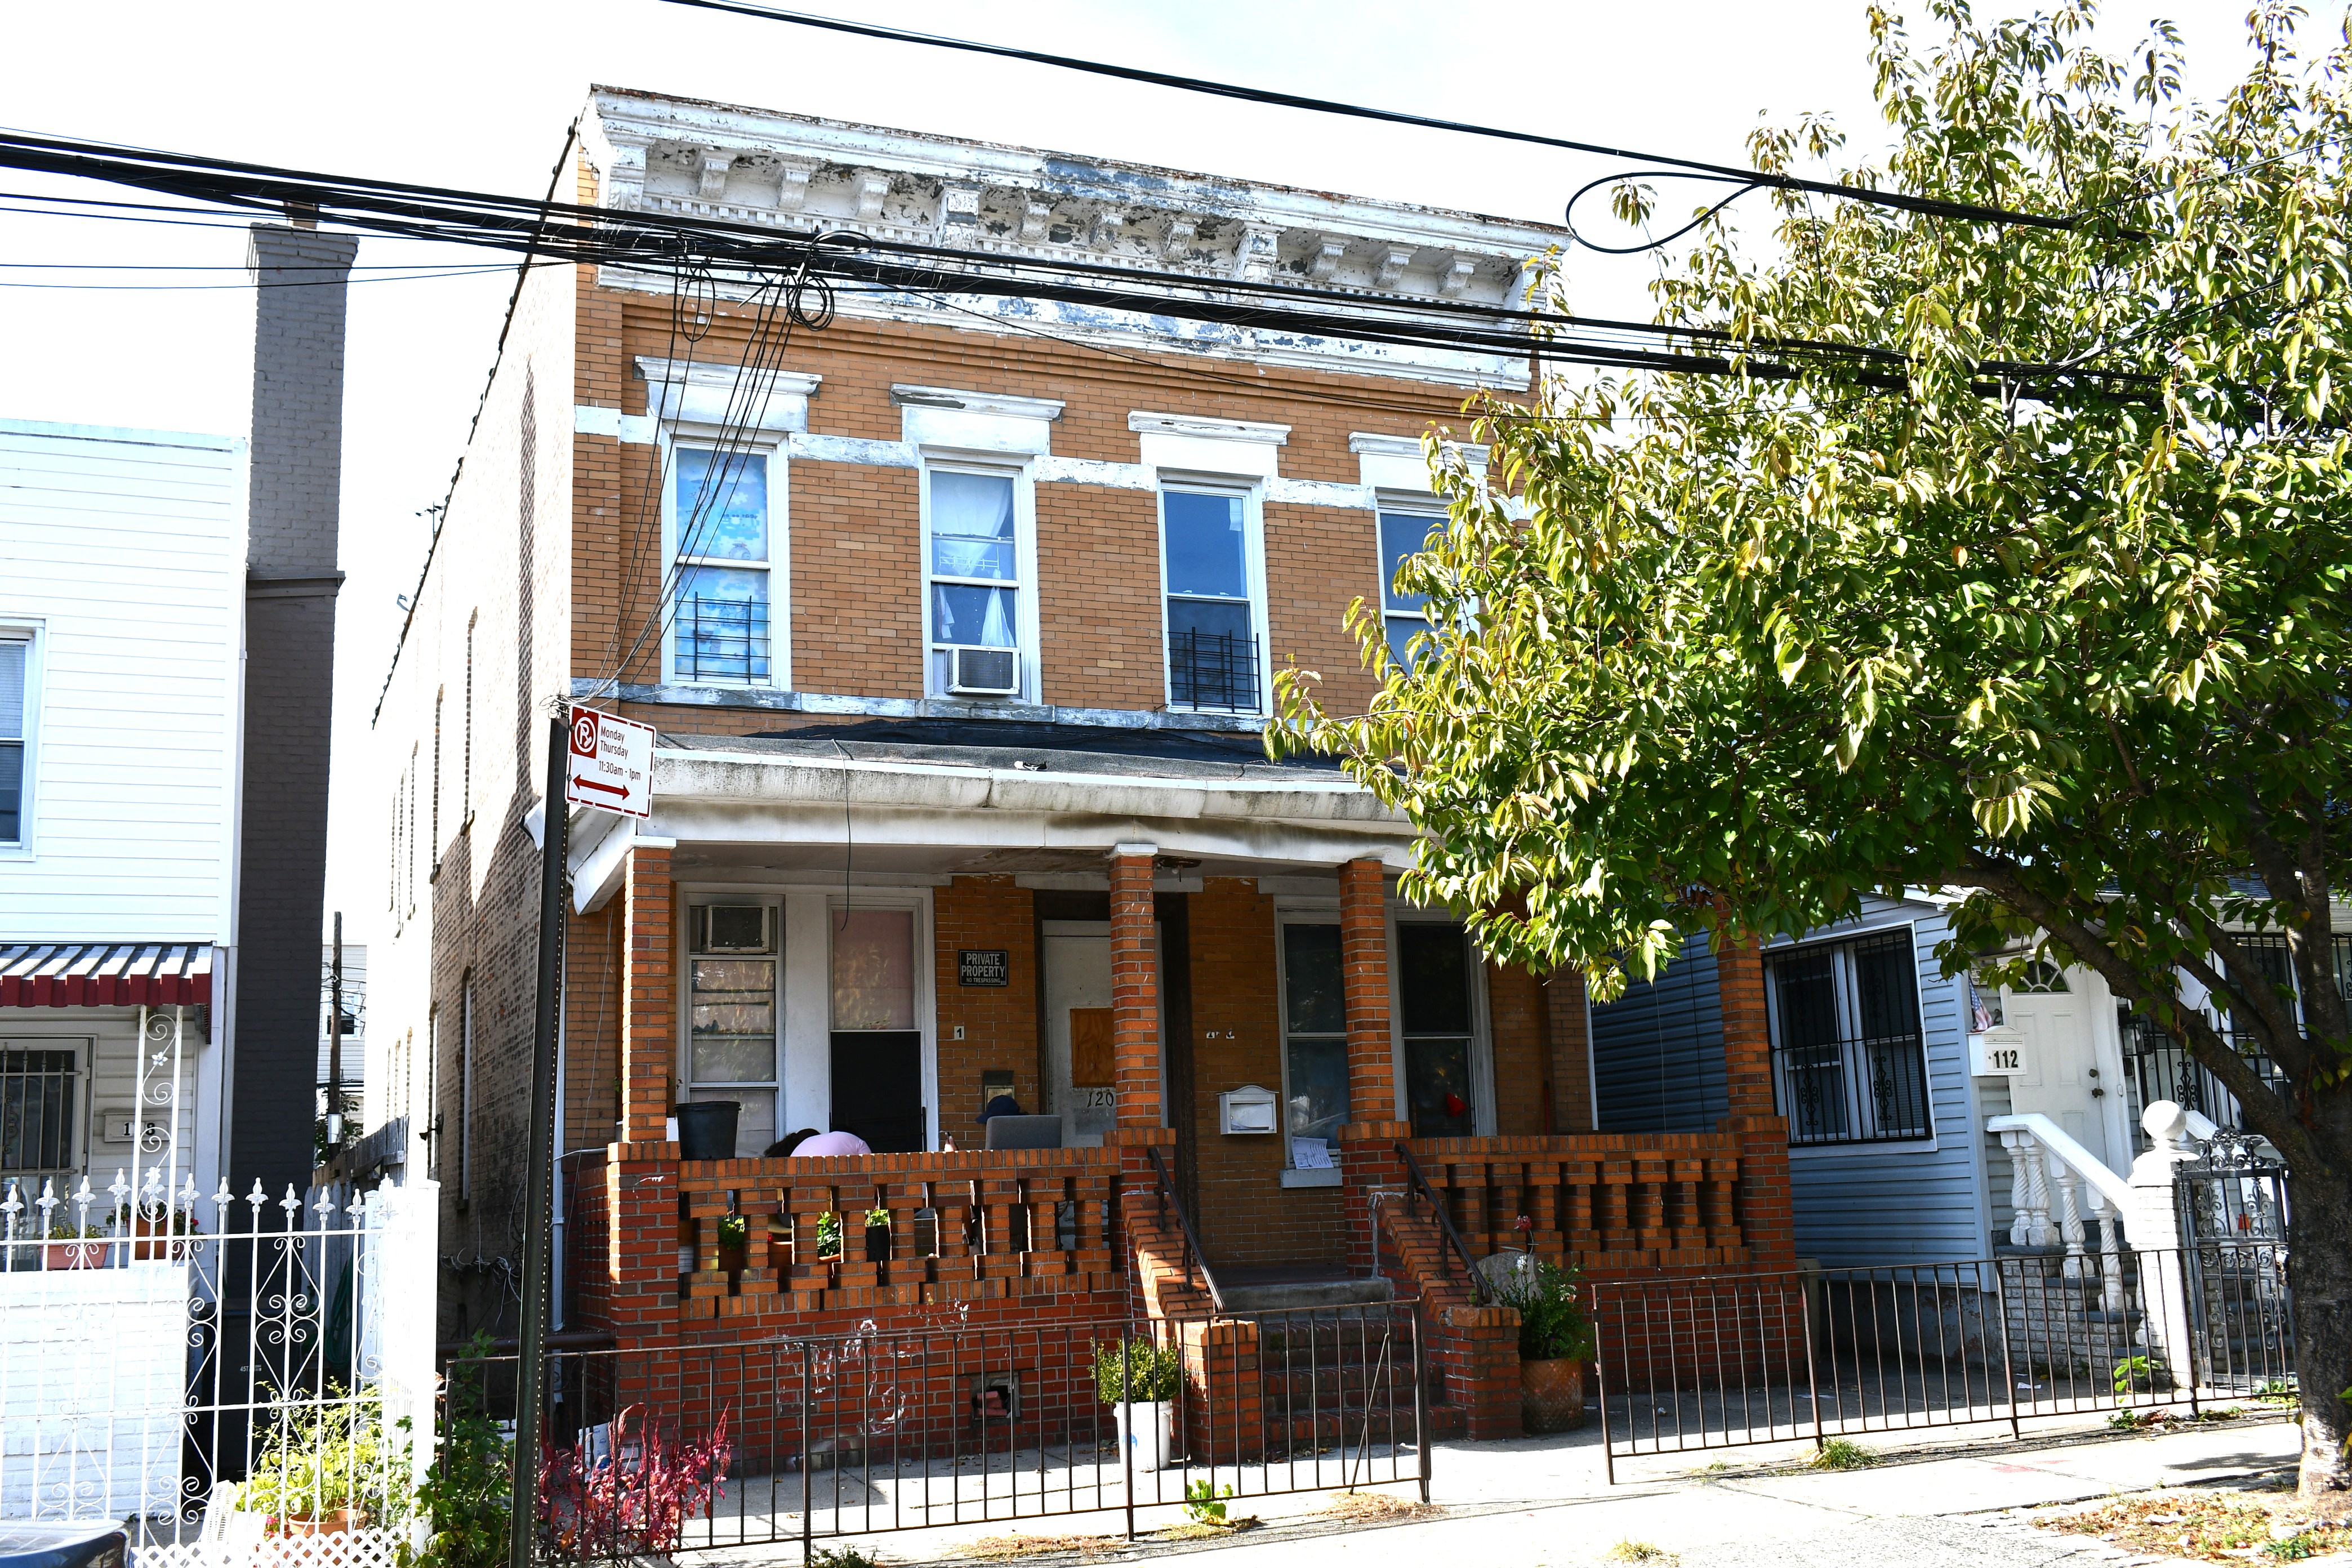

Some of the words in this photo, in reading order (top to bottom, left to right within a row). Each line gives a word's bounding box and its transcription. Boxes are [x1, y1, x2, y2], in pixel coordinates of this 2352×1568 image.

[600, 725, 625, 744] Monday
[600, 740, 629, 760] Thursday
[599, 760, 623, 777] 11:30am
[629, 768, 641, 781] 1pm
[966, 953, 1000, 965] PRIVATE
[961, 965, 1005, 977] PROPERTY
[957, 1028, 962, 1038] 1
[1993, 1050, 2019, 1068] 112
[1087, 1091, 1114, 1108] 120
[123, 1122, 155, 1136] 18
